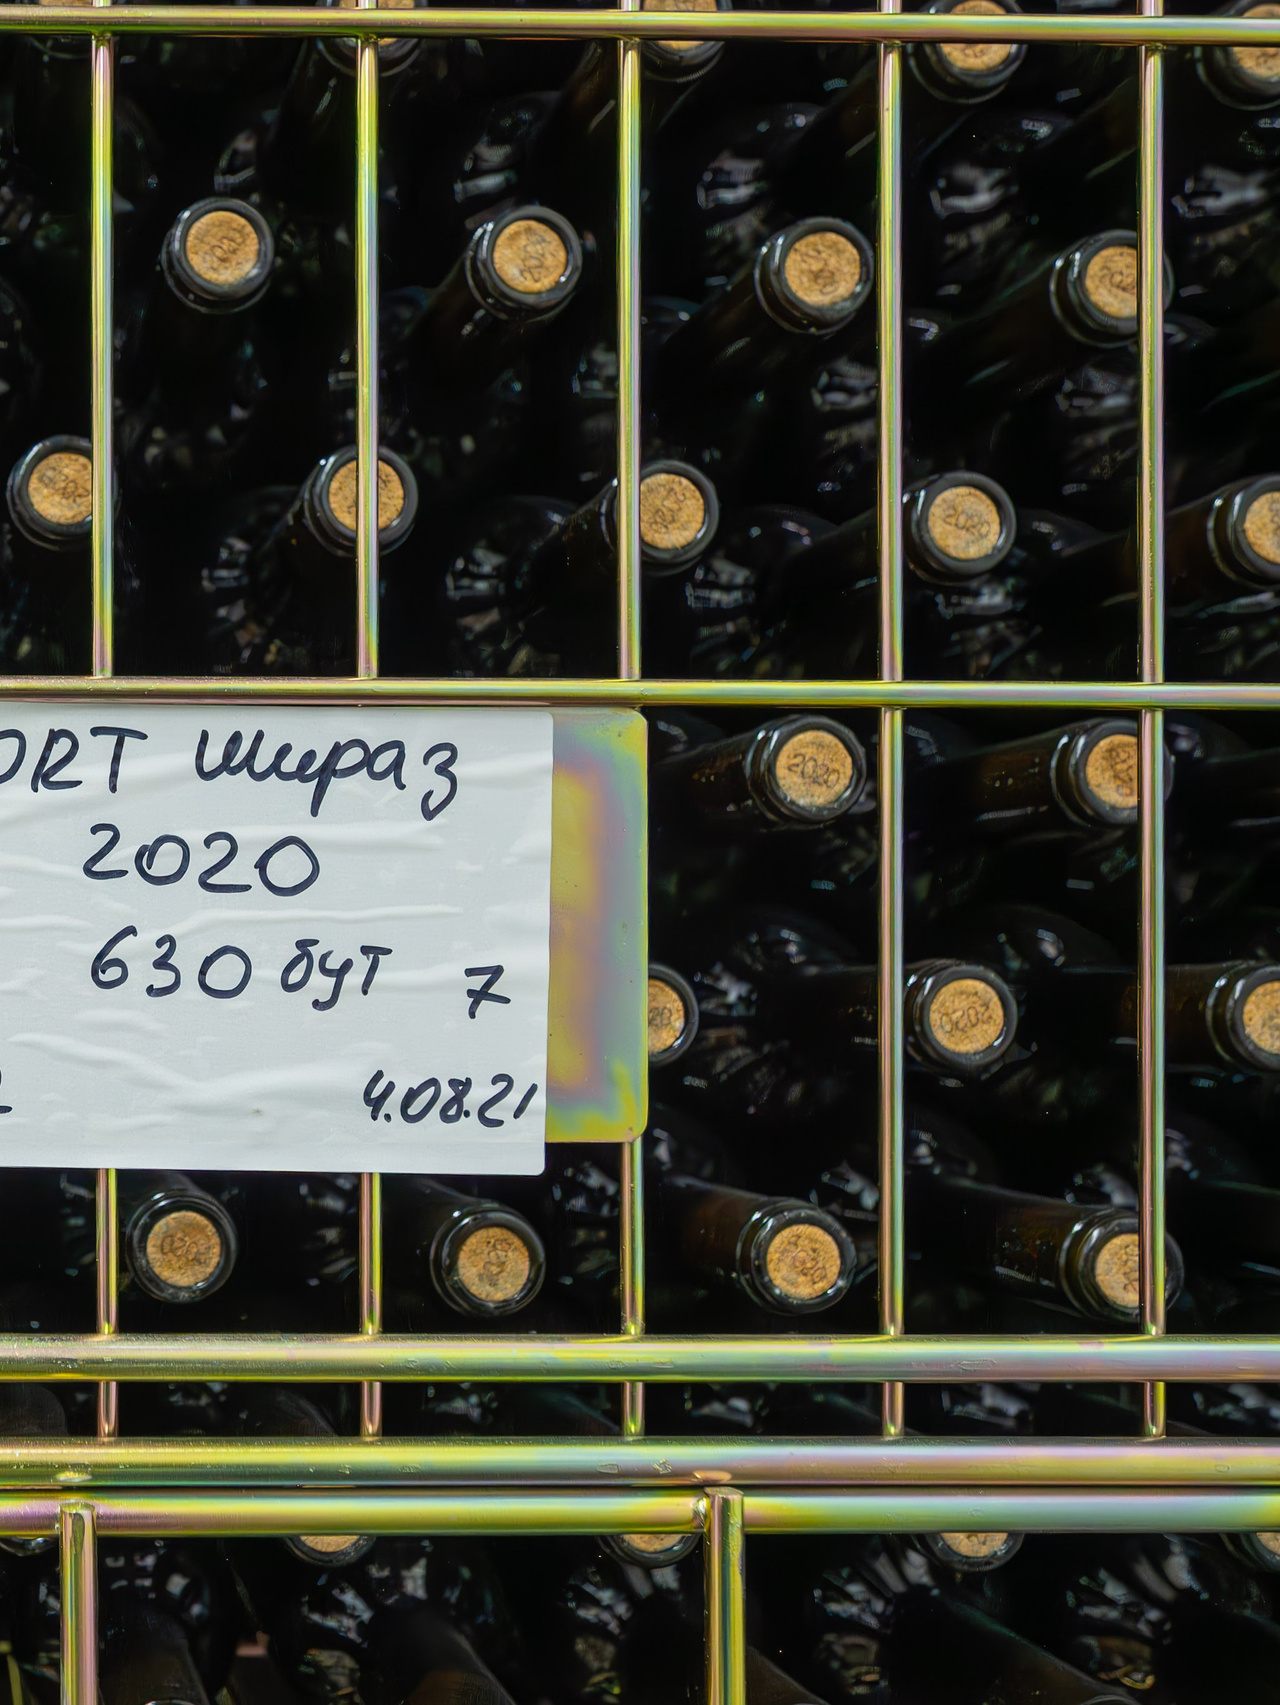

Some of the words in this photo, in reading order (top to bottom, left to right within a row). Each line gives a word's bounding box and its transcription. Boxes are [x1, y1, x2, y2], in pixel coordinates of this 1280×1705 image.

[942, 503, 992, 540] 2020
[786, 751, 842, 790] 2020
[82, 822, 320, 897] 2020
[90, 925, 252, 999] 630
[280, 938, 393, 1012] бут
[464, 964, 512, 1020] 7
[939, 1002, 991, 1034] 2020
[363, 1069, 538, 1128] 4.08.21
